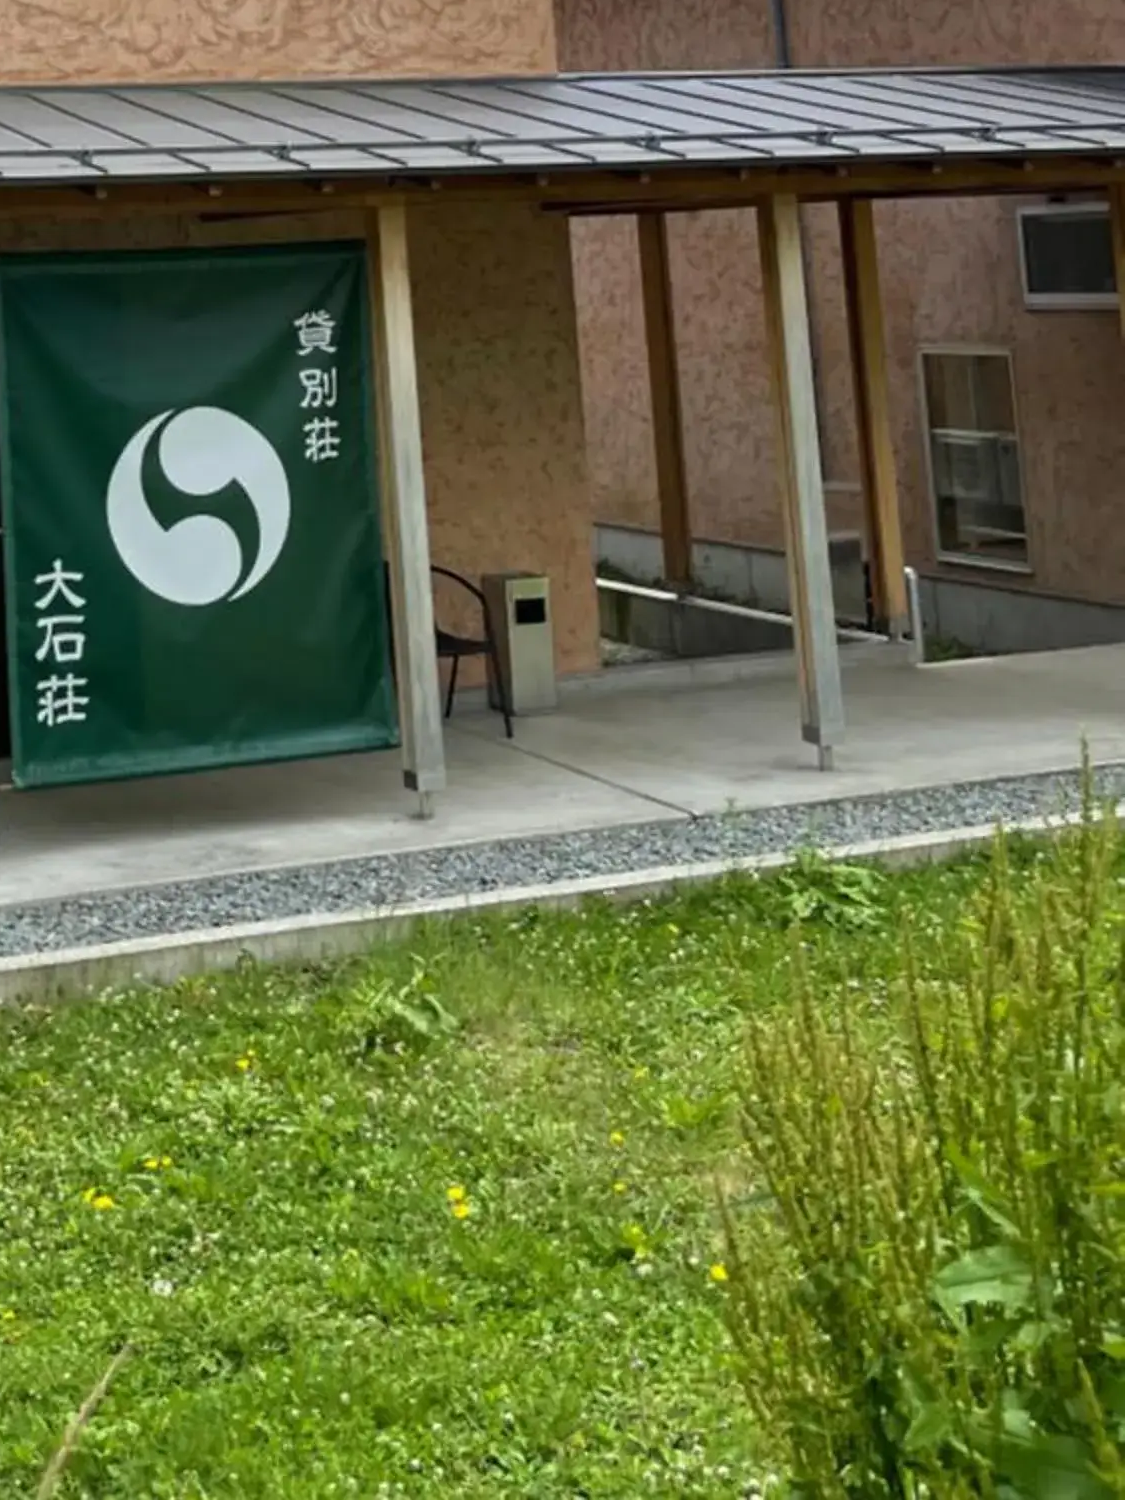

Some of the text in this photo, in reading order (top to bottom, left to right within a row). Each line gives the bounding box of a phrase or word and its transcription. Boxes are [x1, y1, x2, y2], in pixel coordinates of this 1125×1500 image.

[293, 309, 341, 462] 貸別荘
[34, 558, 90, 727] 大石荘
